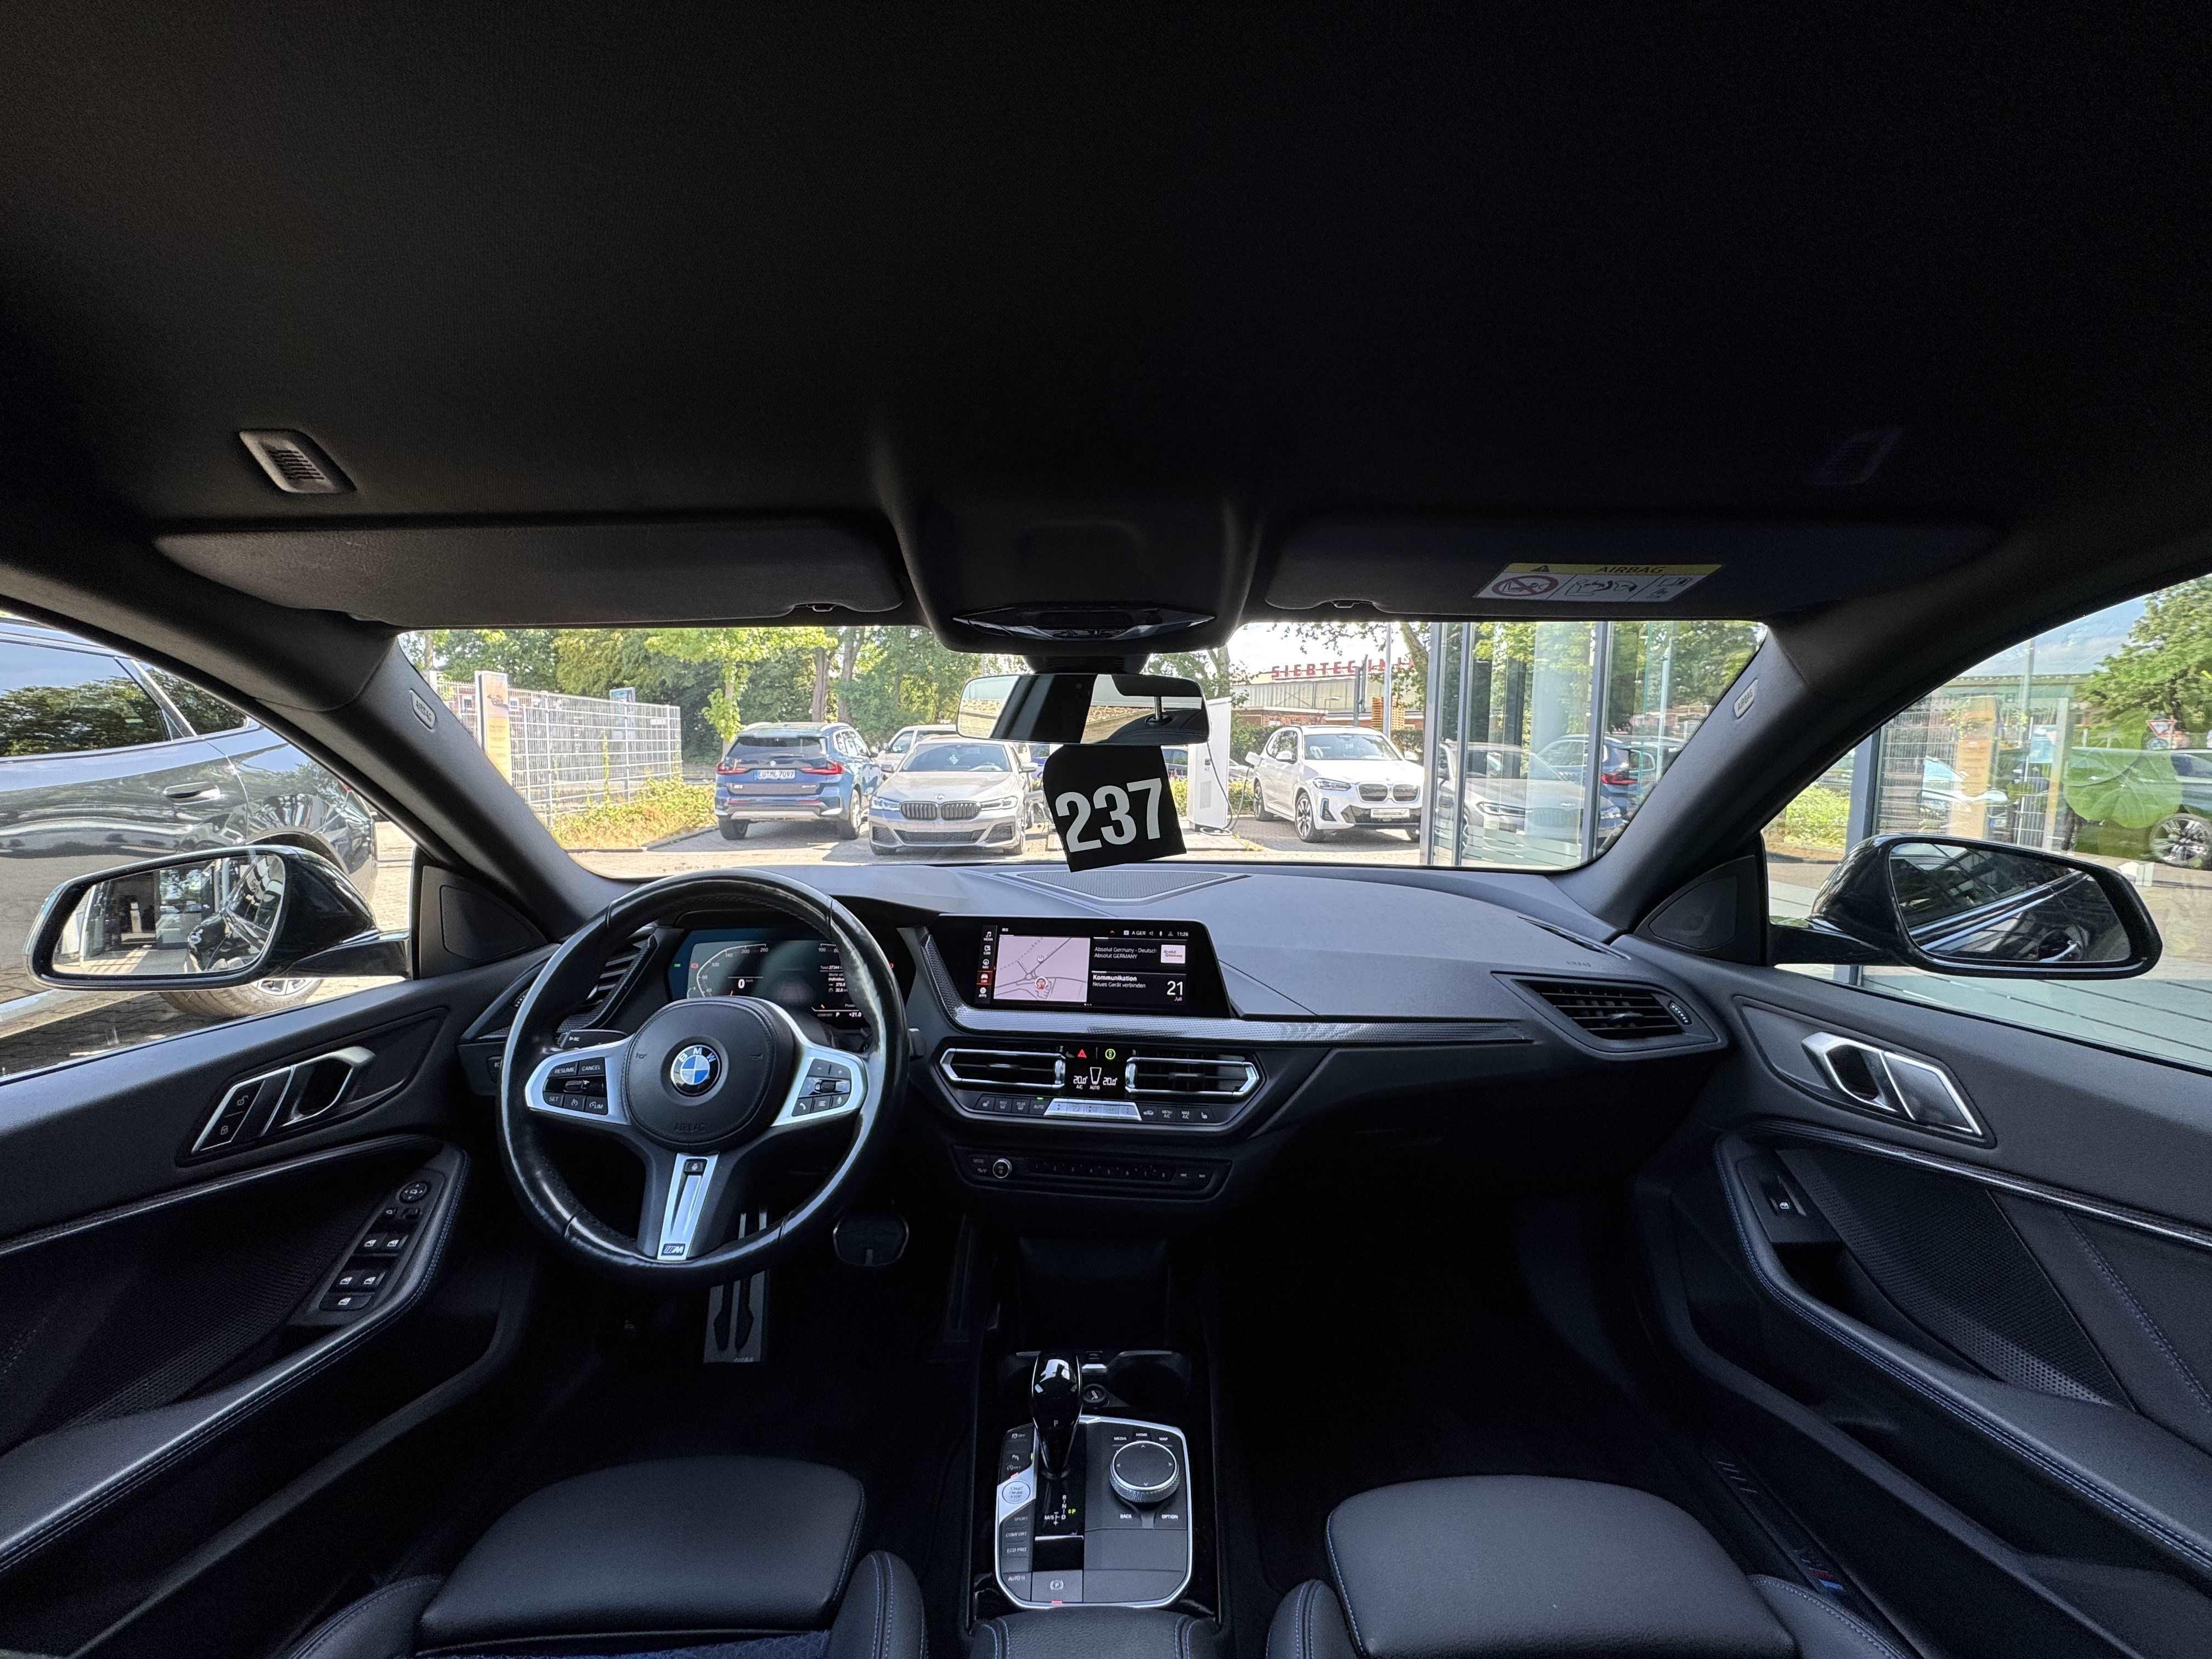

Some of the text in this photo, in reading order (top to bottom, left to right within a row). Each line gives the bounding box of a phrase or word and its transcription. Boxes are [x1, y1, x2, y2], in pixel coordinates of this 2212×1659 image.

[1594, 566, 1664, 574] AIRBAG
[1737, 689, 1753, 712] AIRBAG
[415, 699, 432, 723] AIRBAG
[1055, 777, 1163, 853] 237
[738, 978, 745, 989] 0
[1166, 980, 1183, 996] 21
[679, 1047, 716, 1063] BMW
